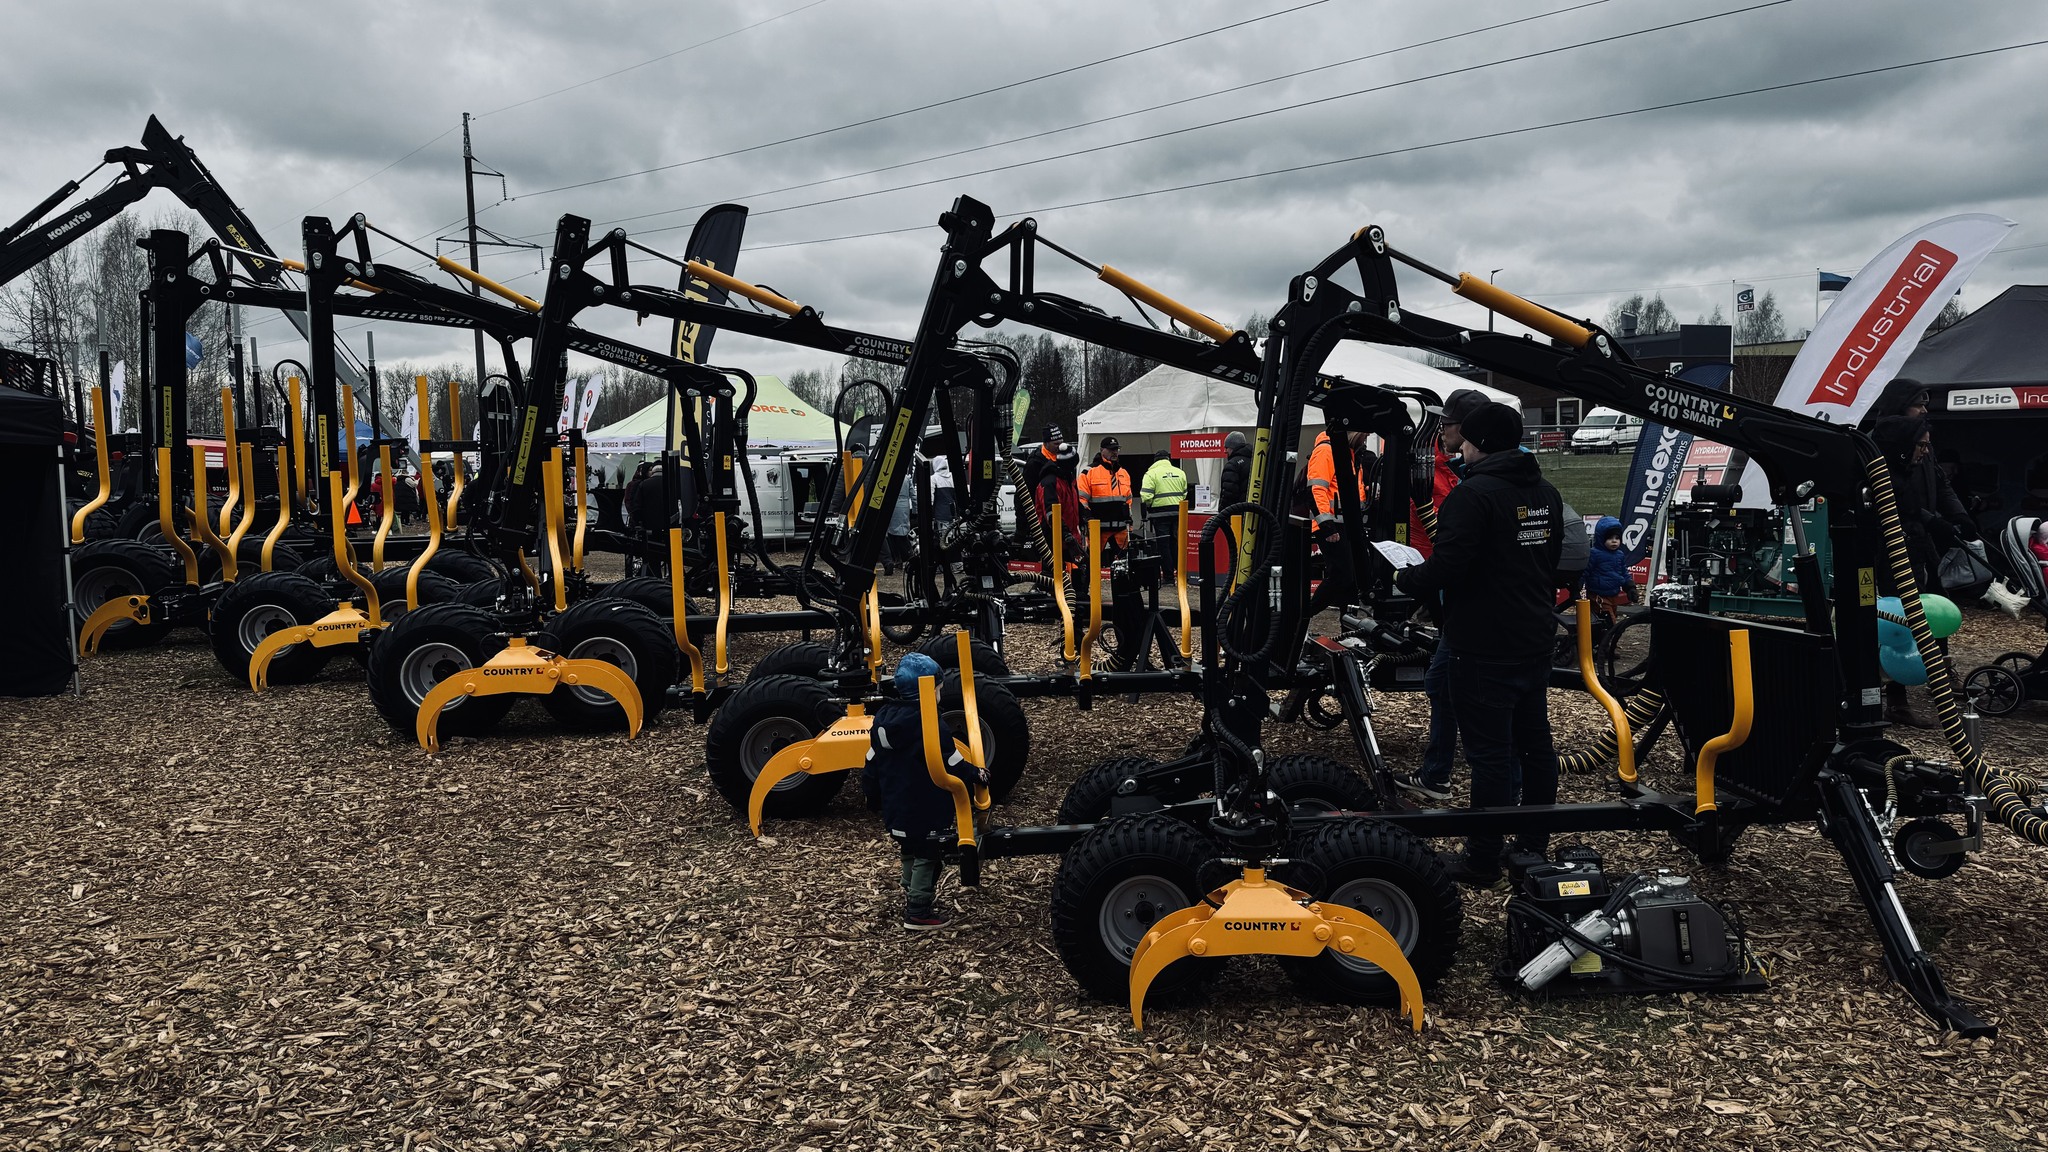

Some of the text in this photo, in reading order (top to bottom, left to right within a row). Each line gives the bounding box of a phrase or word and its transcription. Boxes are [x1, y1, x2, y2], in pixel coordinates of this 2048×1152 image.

[46, 210, 92, 240] KOMATSU
[1825, 253, 1941, 396] Industrial
[597, 342, 640, 359] COUNTRY
[854, 336, 906, 353] COUNTRY
[600, 349, 639, 365] 670 MASTER
[858, 346, 904, 360] 550 MASTER
[1645, 384, 1719, 415] COUNTRY
[1953, 394, 2012, 406] Baltic
[1649, 401, 1723, 428] 410 SMART
[1180, 440, 1221, 448] HYDRACOM
[1668, 440, 1688, 480] Systems
[1254, 480, 1261, 489] M
[317, 622, 357, 631] COUNTRY
[483, 667, 534, 676] COUNTRY
[1224, 921, 1287, 931] COUNTRY
